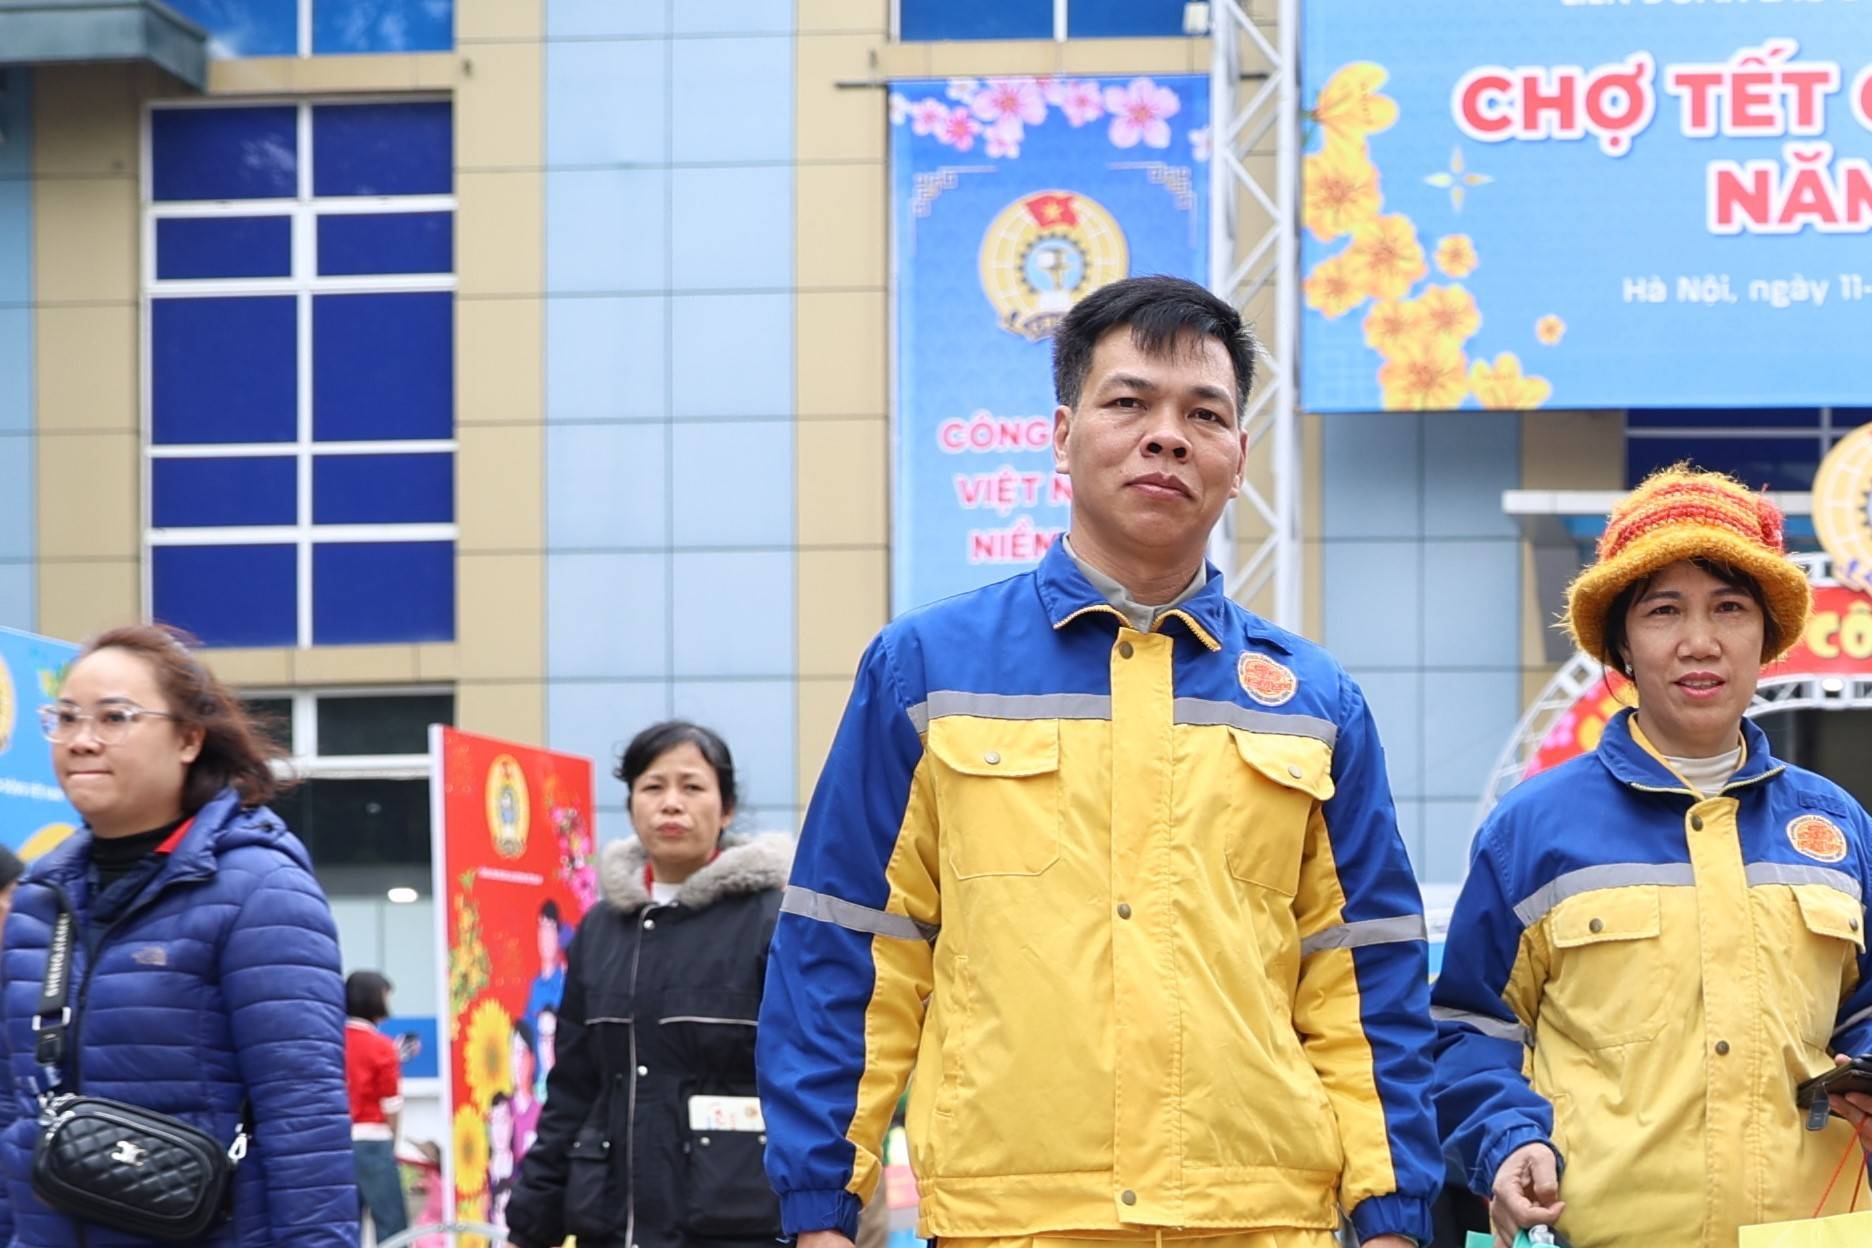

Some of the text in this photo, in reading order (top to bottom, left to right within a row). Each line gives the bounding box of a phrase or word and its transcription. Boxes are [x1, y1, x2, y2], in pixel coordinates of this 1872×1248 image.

[1457, 57, 1651, 152] CHỢ
[1670, 43, 1835, 131] TẾT
[1622, 275, 1667, 303] Hà
[1749, 272, 1829, 308] ngày
[941, 413, 1051, 450] CÔNG
[956, 467, 1042, 513] VIỆT
